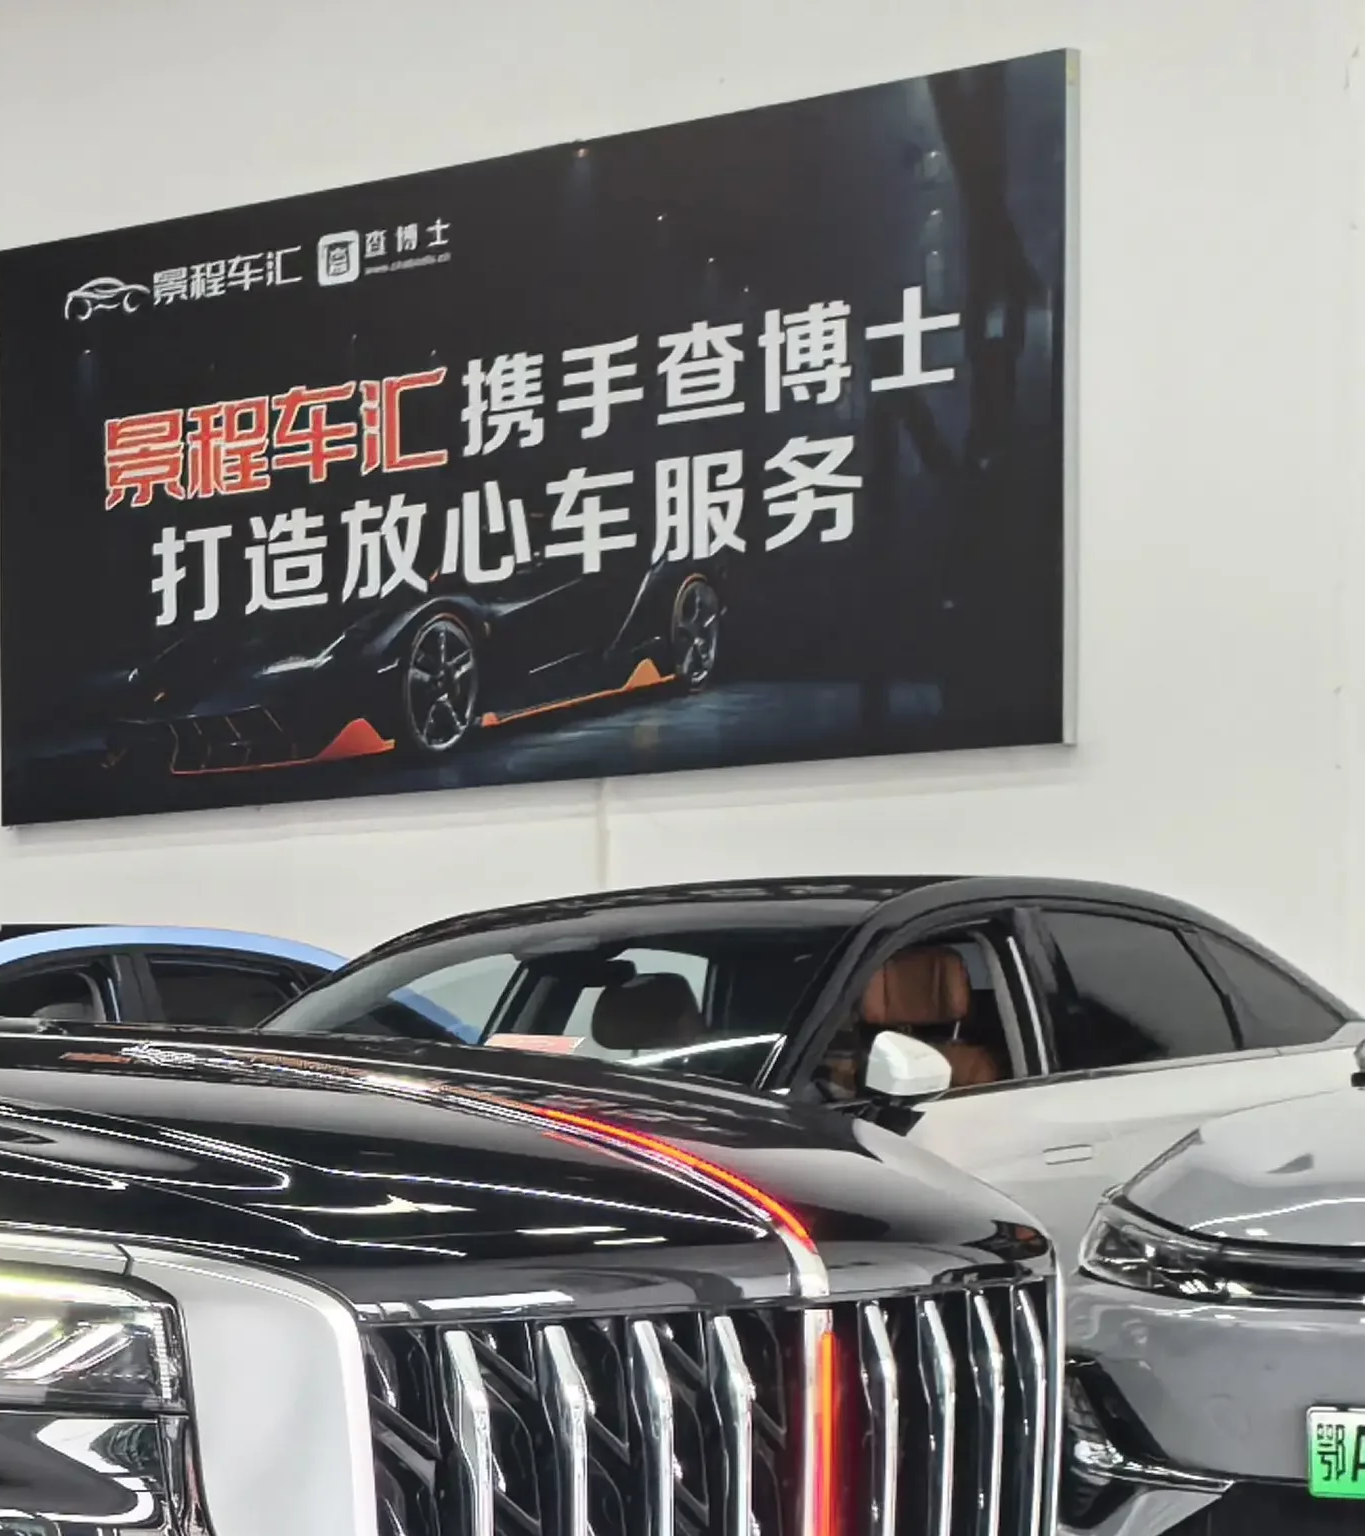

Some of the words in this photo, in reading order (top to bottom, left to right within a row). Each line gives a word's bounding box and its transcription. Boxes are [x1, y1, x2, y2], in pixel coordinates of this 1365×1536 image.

[364, 217, 451, 258] 查博士
[152, 245, 303, 305] 景程车汇
[150, 434, 864, 627] 打造放心车服务
